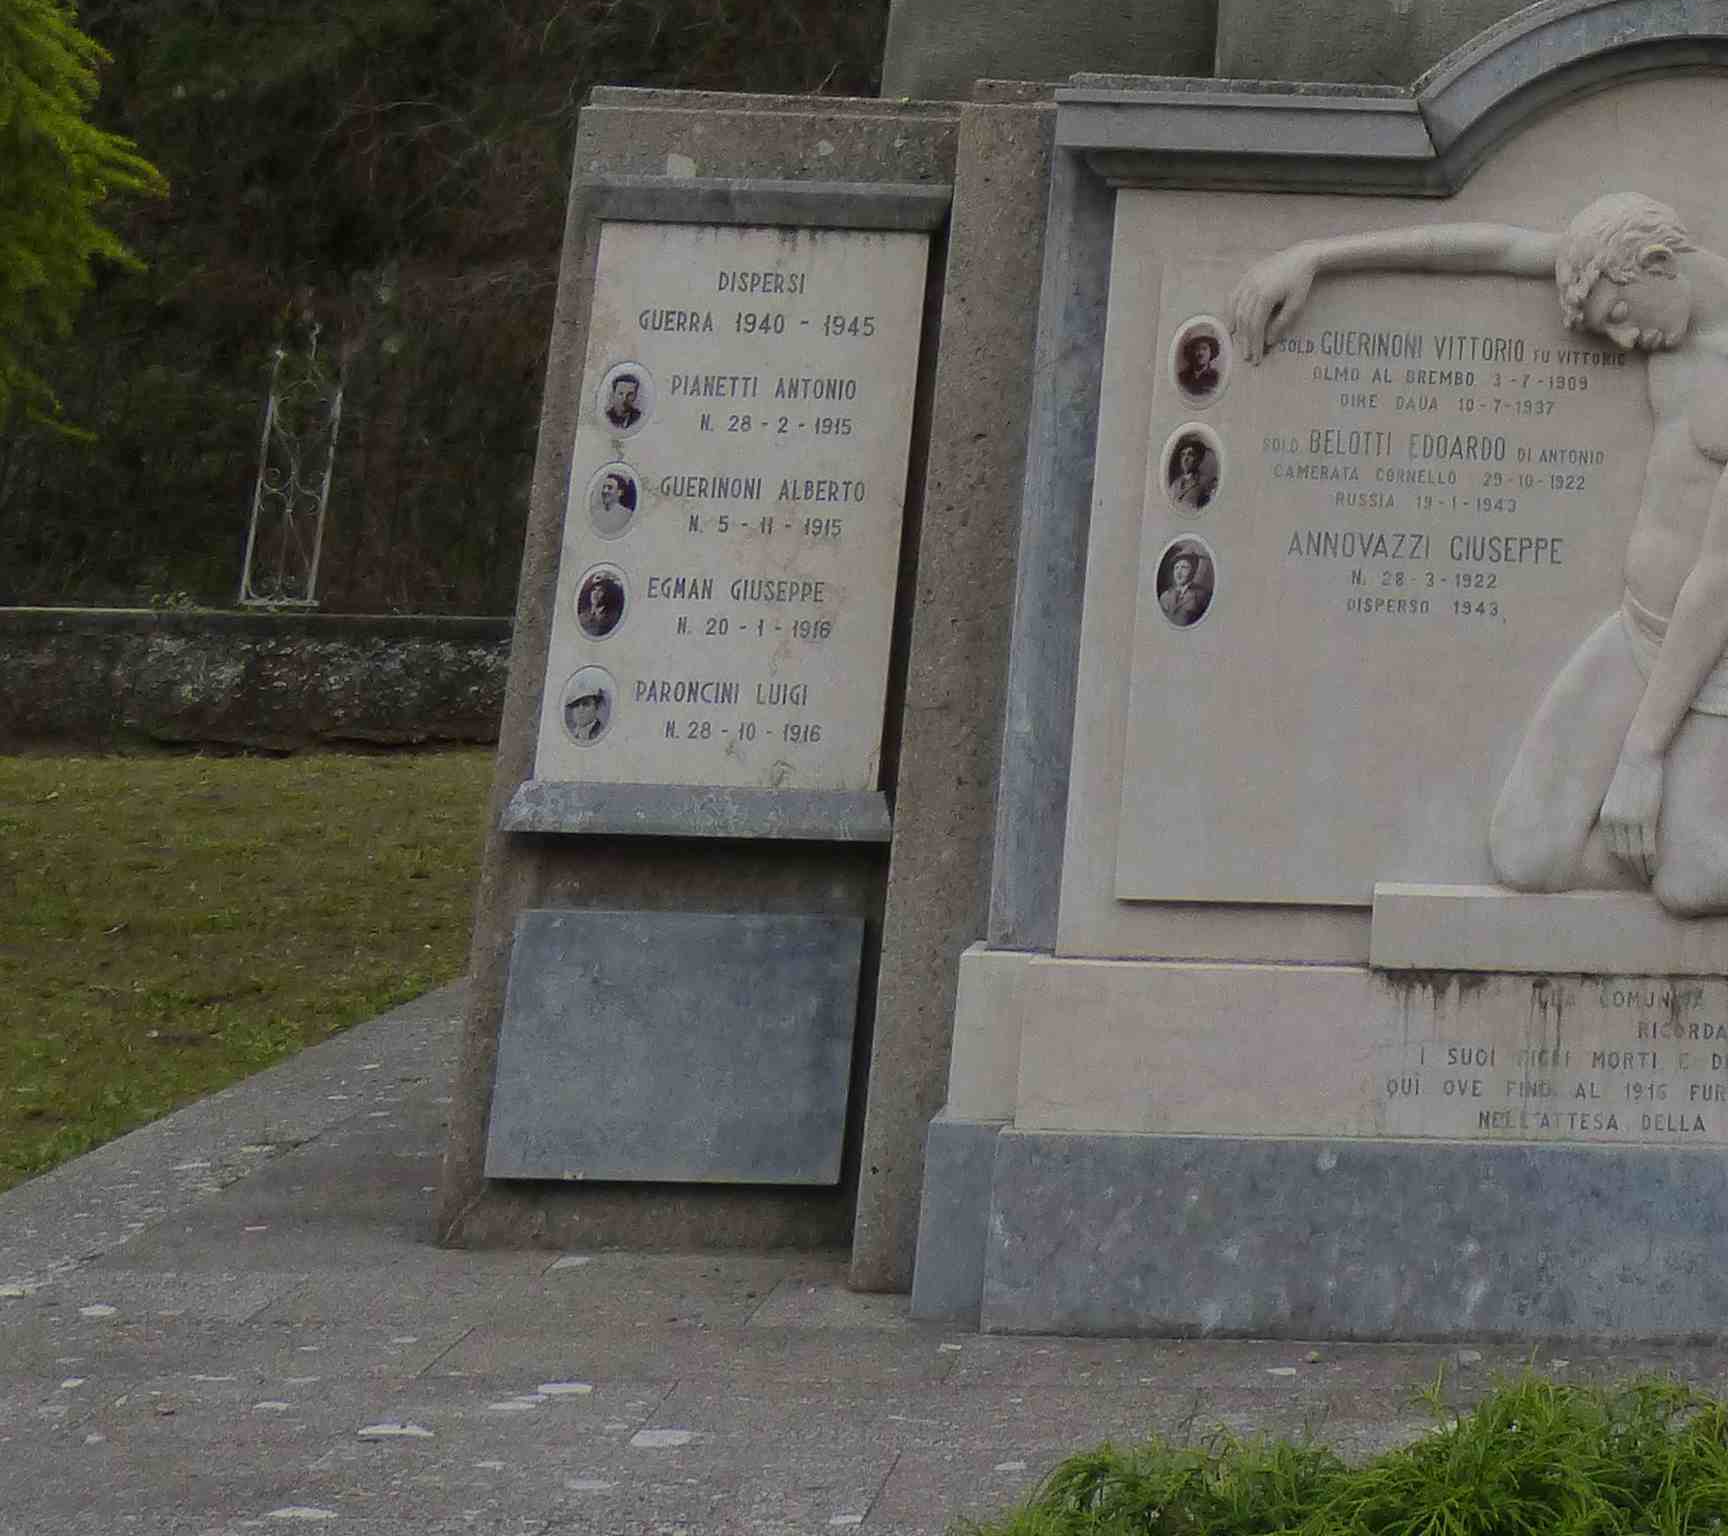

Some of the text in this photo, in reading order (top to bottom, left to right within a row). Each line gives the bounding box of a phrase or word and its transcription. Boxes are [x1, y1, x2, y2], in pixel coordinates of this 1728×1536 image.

[718, 272, 806, 295] DISPERSI
[638, 310, 876, 337] GUERRA 1940 1945
[1321, 331, 1525, 362] GUERINONI VITTORIO
[670, 375, 857, 400] PIANETTI ANTONIO
[814, 417, 853, 436] 1915
[1309, 429, 1605, 464] BELOTTI EDOARDO ANTONIO
[1273, 466, 1457, 484] CAMERATA CORNELLO
[660, 476, 866, 503] GUERINONI ALBERTO
[1336, 492, 1395, 508] RUSSIA
[804, 519, 842, 538] 1915
[1287, 530, 1564, 566] ANNOVAZZI GIUSEPPE
[648, 577, 825, 603] EGMAN GIUSEPPE
[1455, 573, 1498, 589] 1922
[1347, 597, 1499, 617] DISPERSO 1943
[791, 621, 832, 639] 1916
[633, 680, 808, 706] PARONCINI LUIGI
[783, 723, 821, 743] 1916
[1637, 1022, 1728, 1041] RICORDA
[1448, 1047, 1657, 1070] SUOI MORTI
[1443, 1080, 1600, 1099] OVE AL
[1641, 1110, 1706, 1133] DELLA
